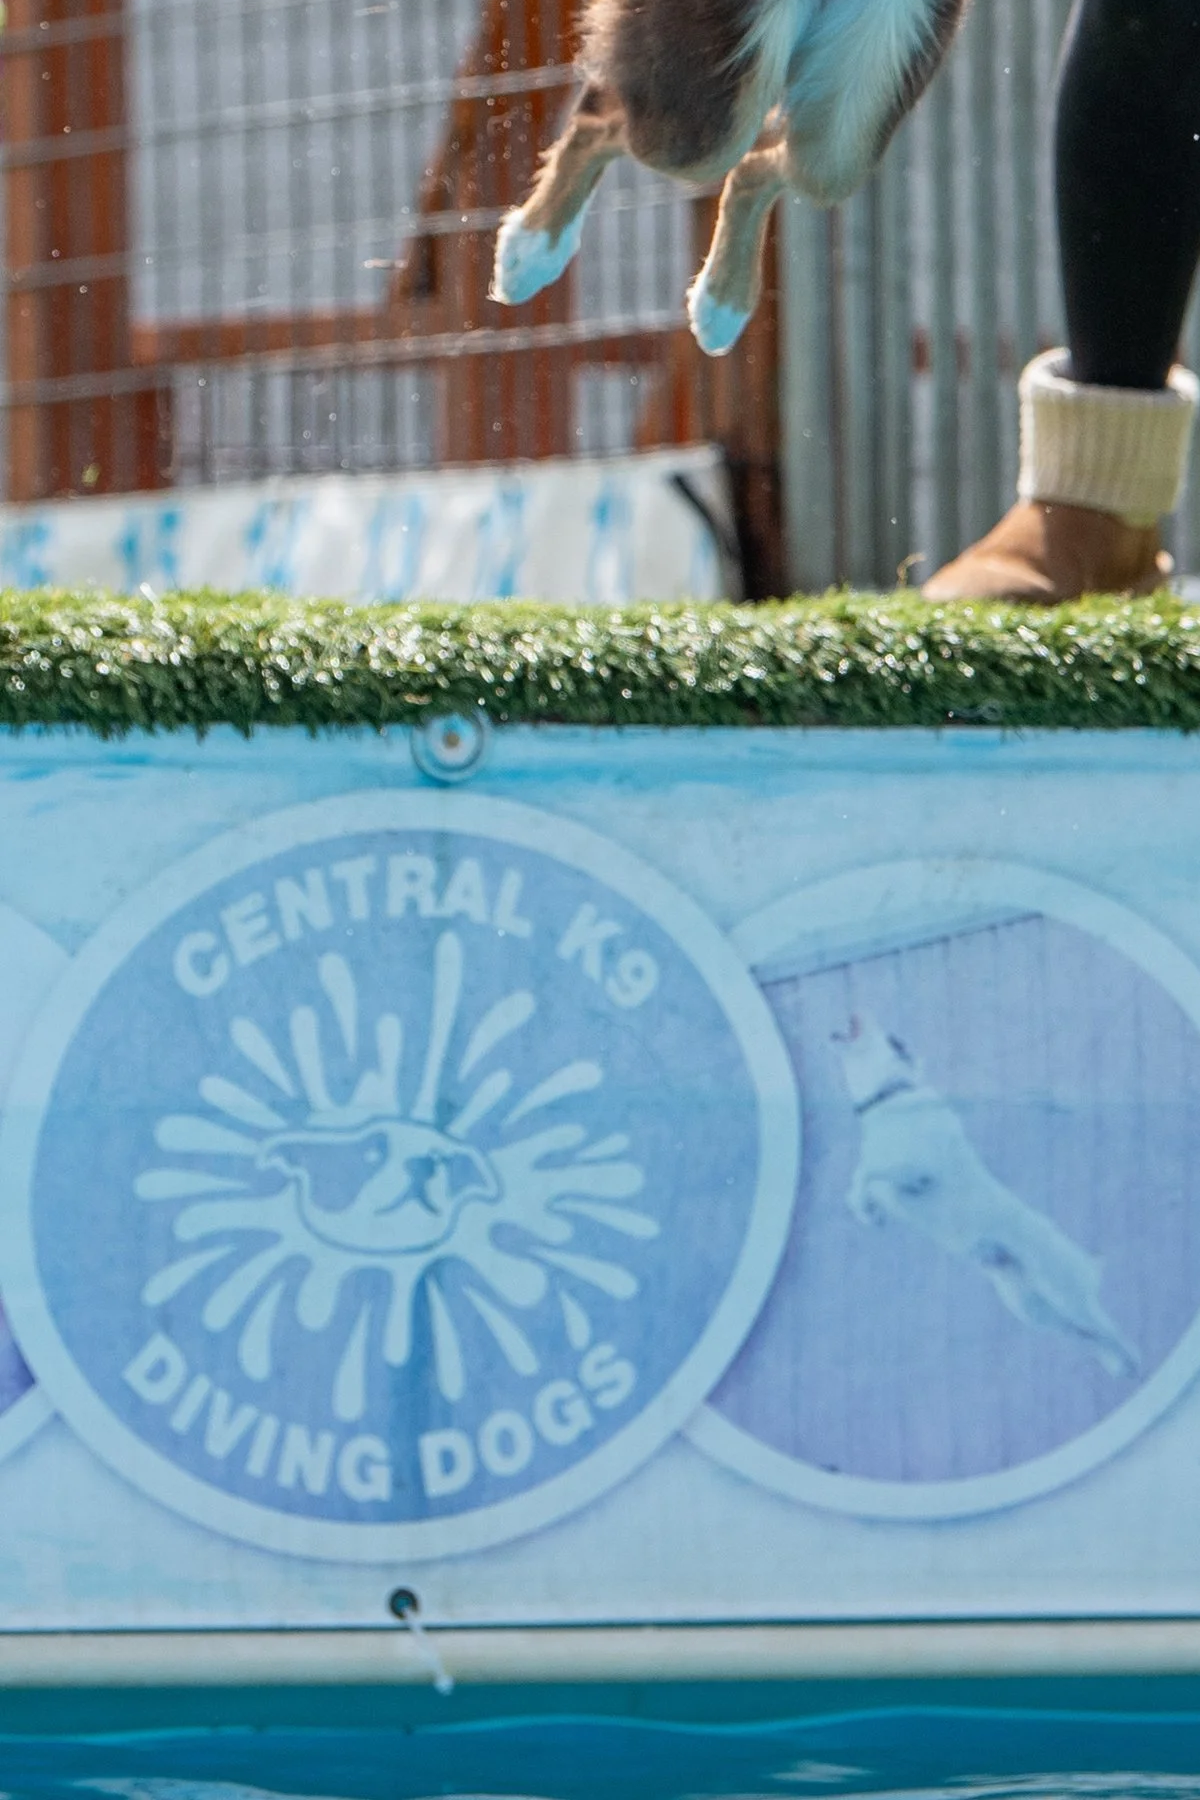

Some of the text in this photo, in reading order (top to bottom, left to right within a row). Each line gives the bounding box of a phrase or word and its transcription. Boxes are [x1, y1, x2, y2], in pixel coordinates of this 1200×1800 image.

[173, 854, 659, 1008] CENTRAL K9
[123, 1333, 638, 1502] DIVING DOGS
